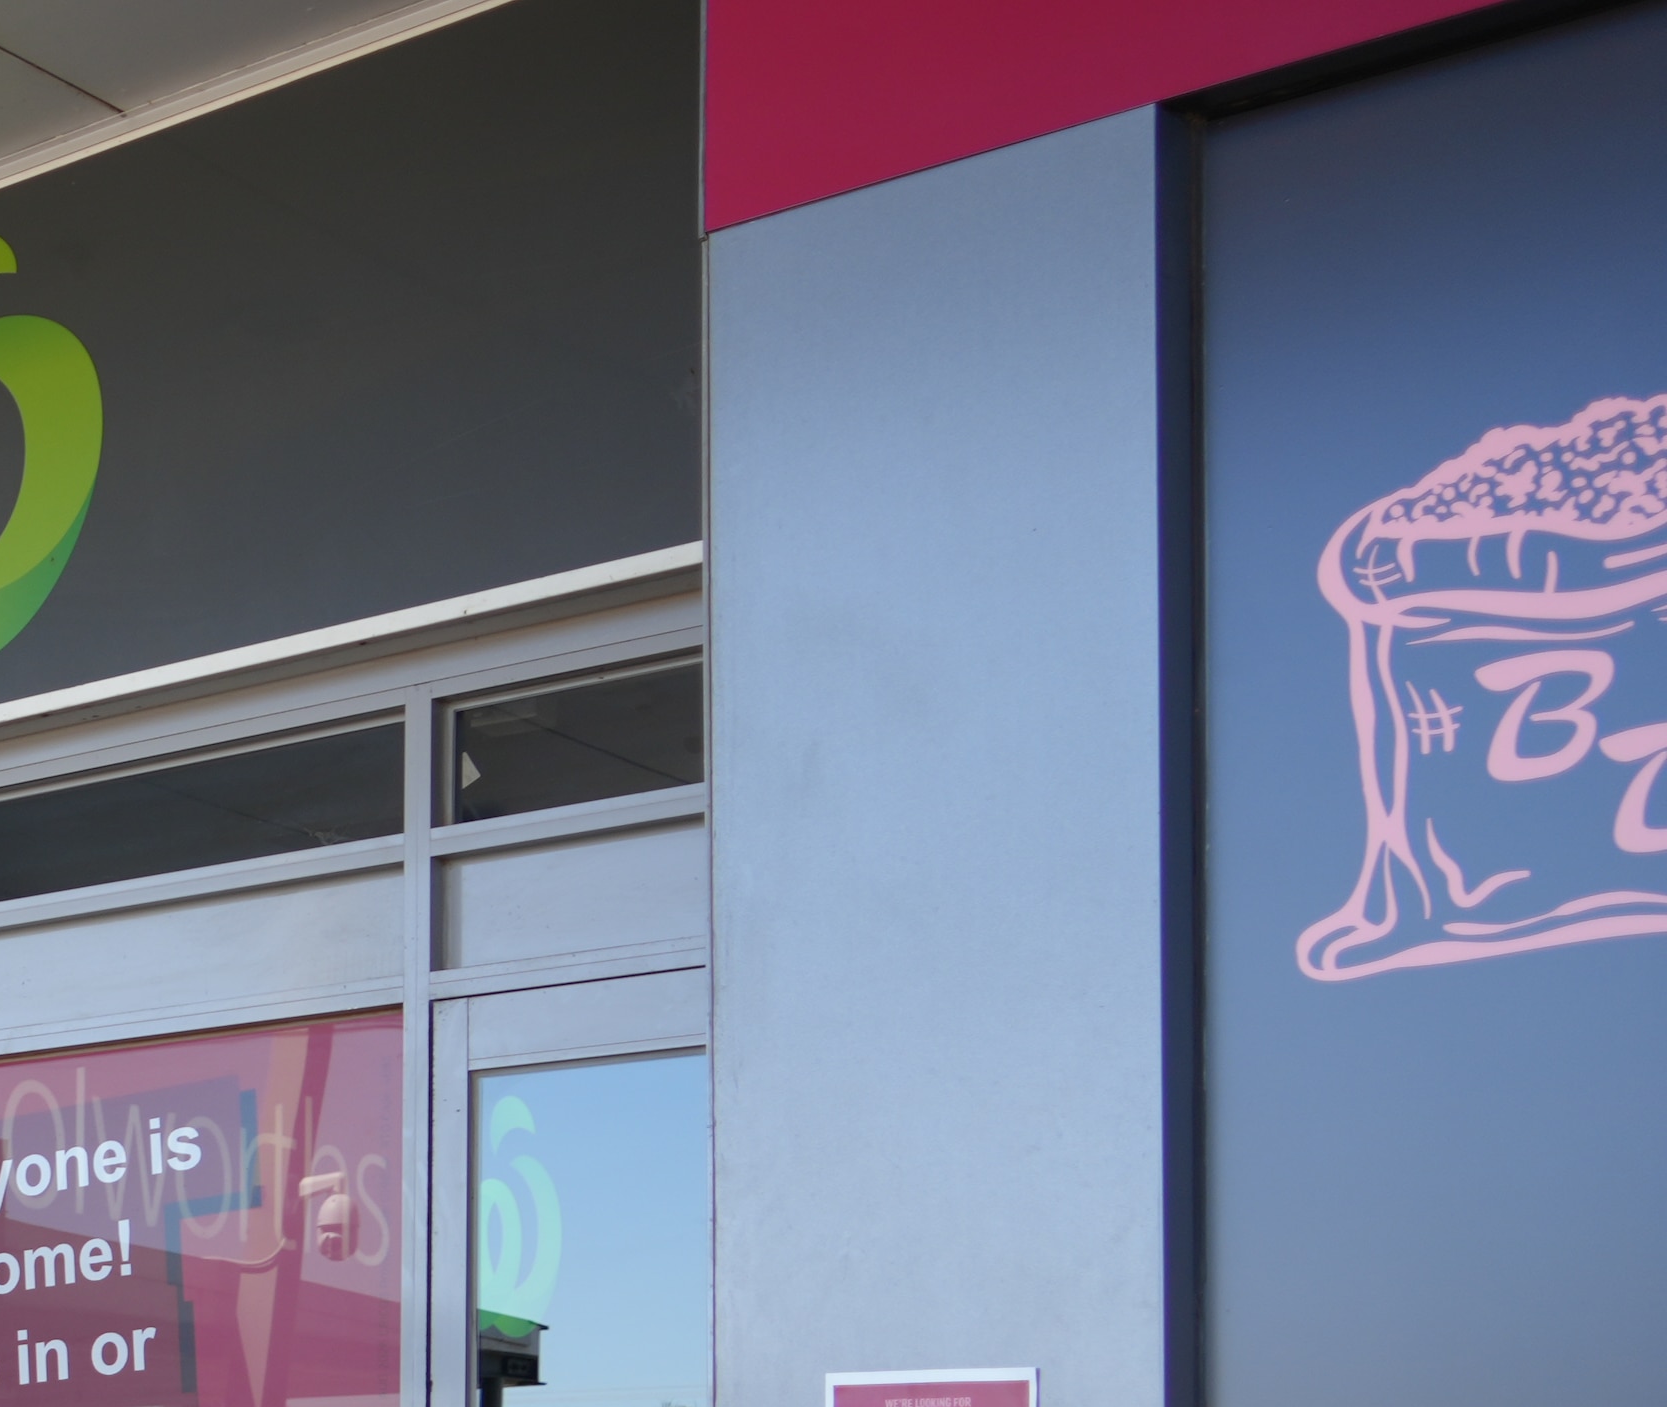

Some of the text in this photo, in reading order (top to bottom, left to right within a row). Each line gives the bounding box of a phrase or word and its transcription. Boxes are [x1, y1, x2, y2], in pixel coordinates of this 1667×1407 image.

[148, 1117, 202, 1177] is
[17, 1329, 69, 1386] in
[90, 1325, 156, 1376] or
[915, 1397, 952, 1407] LOOKING
[954, 1397, 972, 1407] FOR
